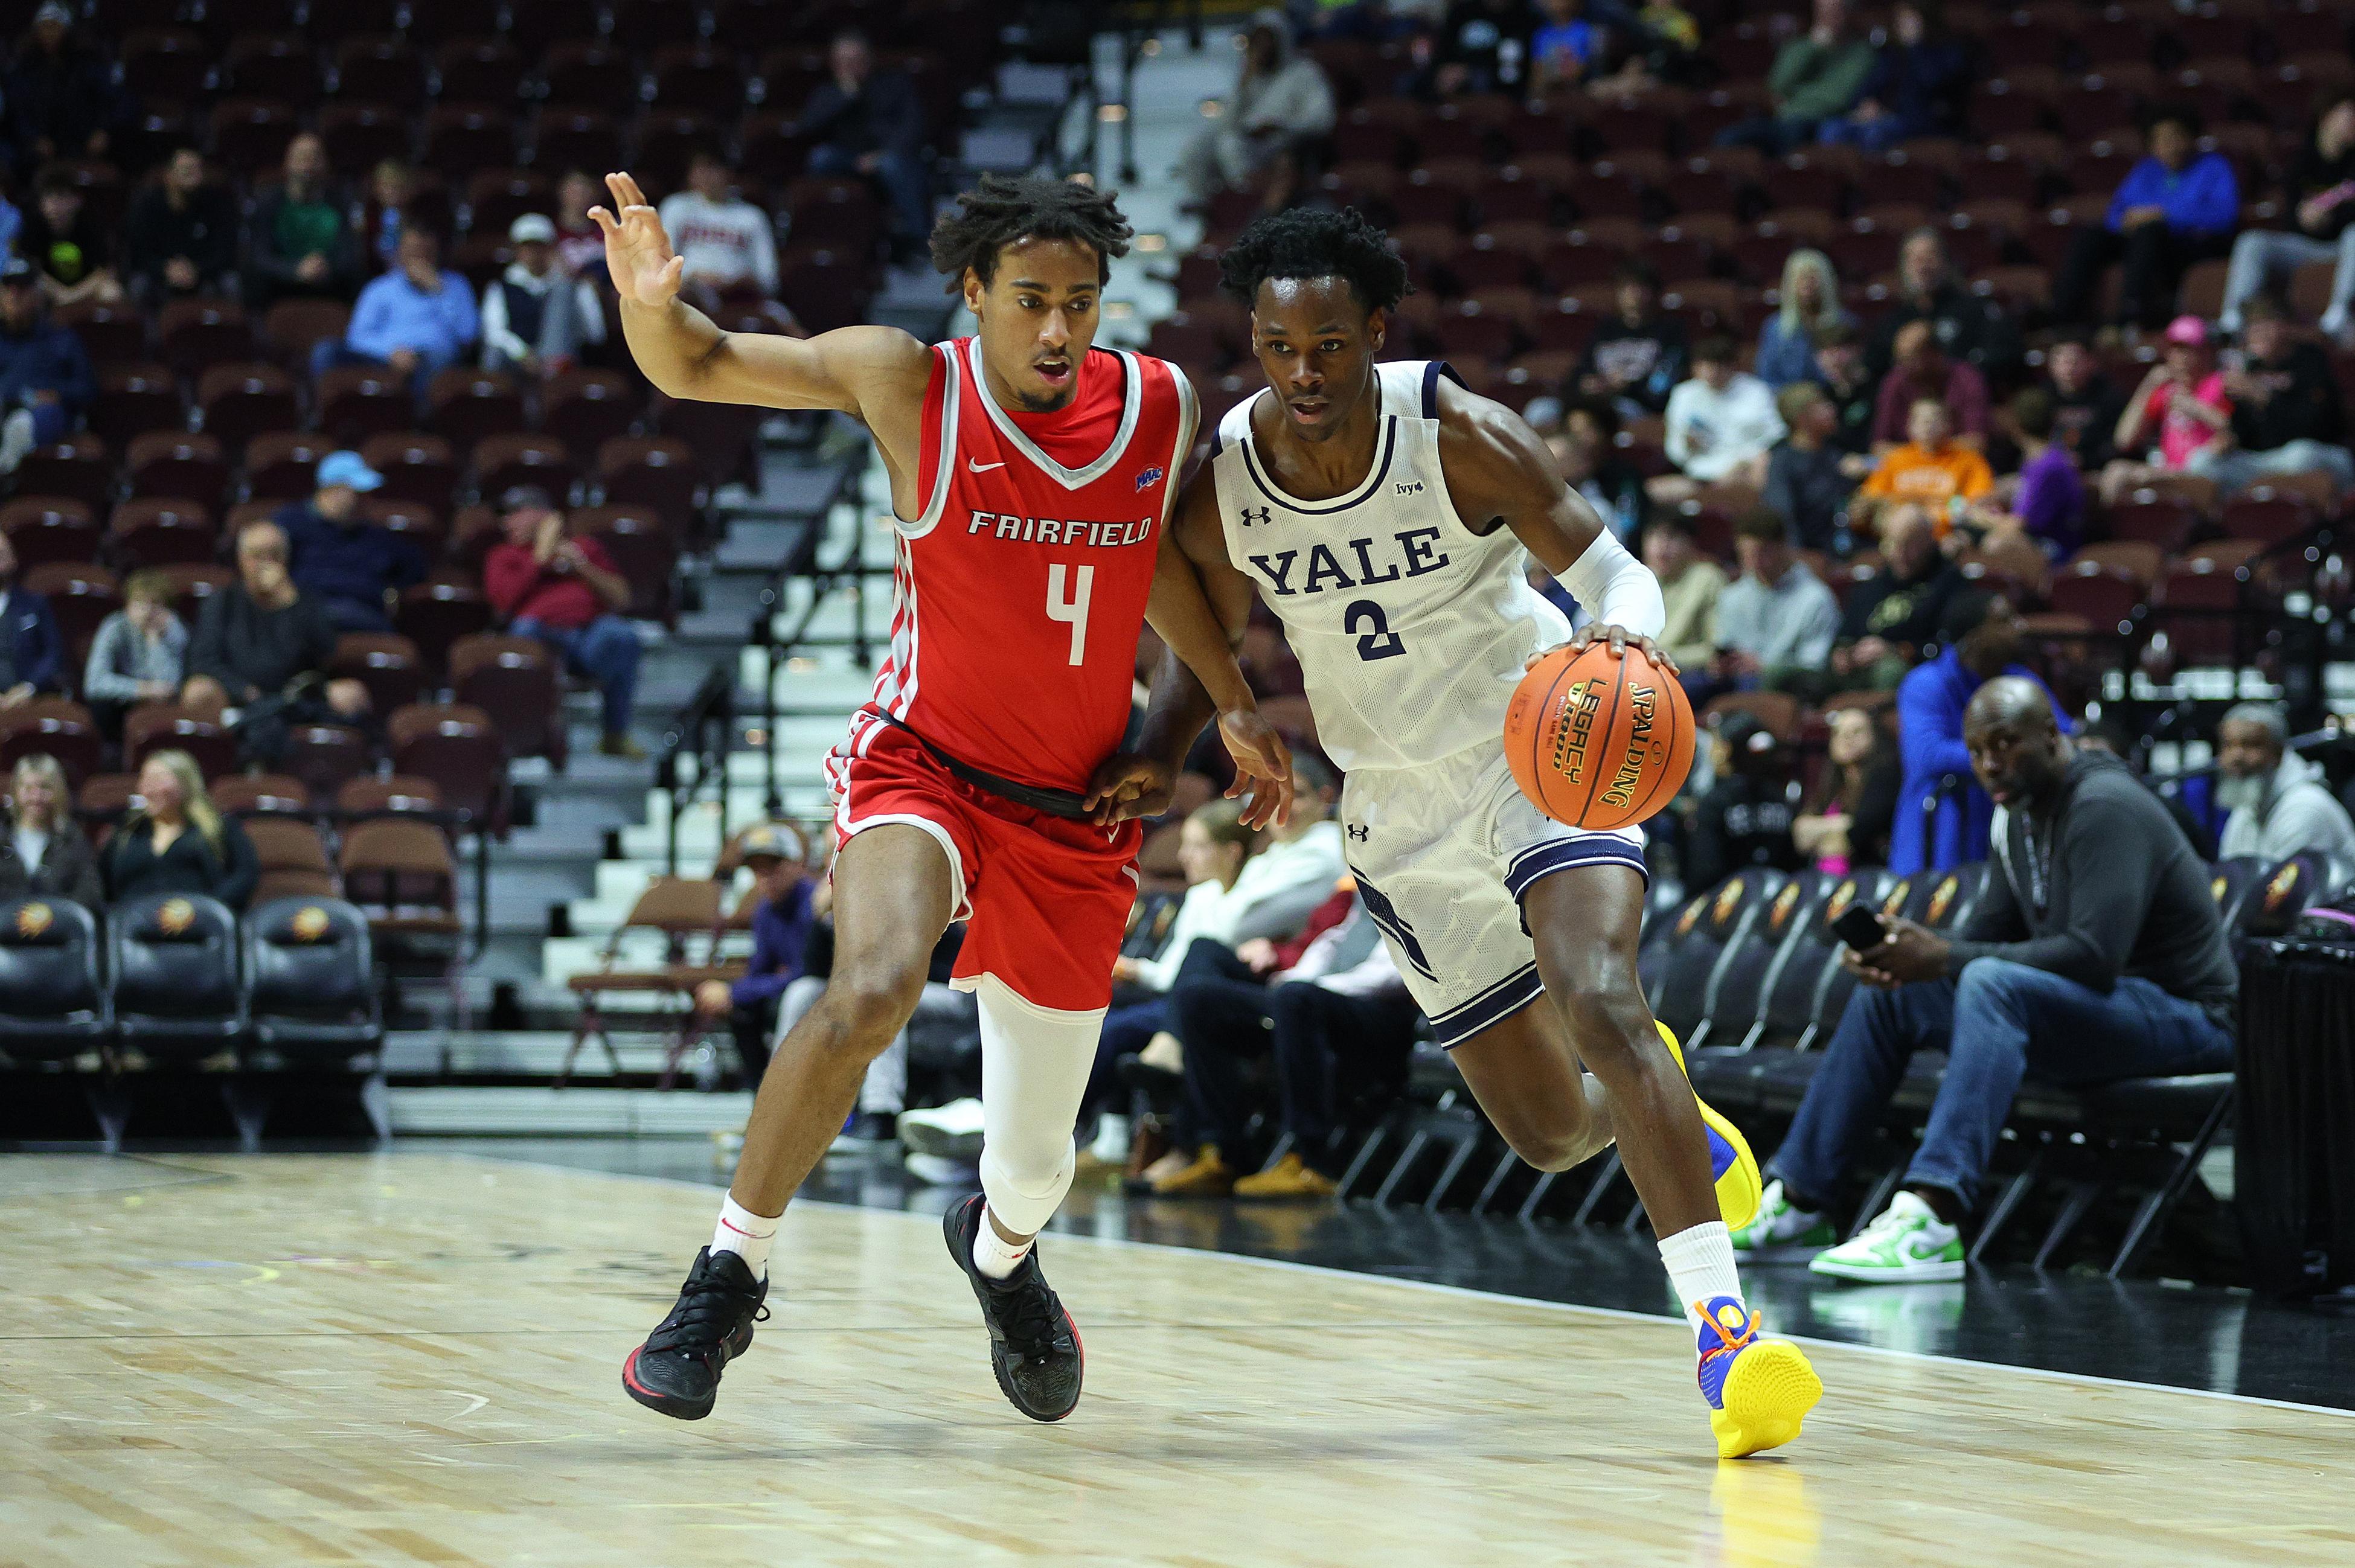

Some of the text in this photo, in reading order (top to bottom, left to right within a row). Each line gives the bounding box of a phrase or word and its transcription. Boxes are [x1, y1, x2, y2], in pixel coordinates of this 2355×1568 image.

[1136, 466, 1163, 493] MAAC
[1395, 483, 1414, 496] Ivy
[967, 510, 1152, 547] FAIRFIELD
[1249, 526, 1450, 595] YALE
[1045, 563, 1095, 667] 4
[1344, 599, 1407, 662] 2
[1552, 703, 1575, 771] 1000
[1563, 677, 1609, 785] LEGACY
[1598, 681, 1657, 809] SPALDING
